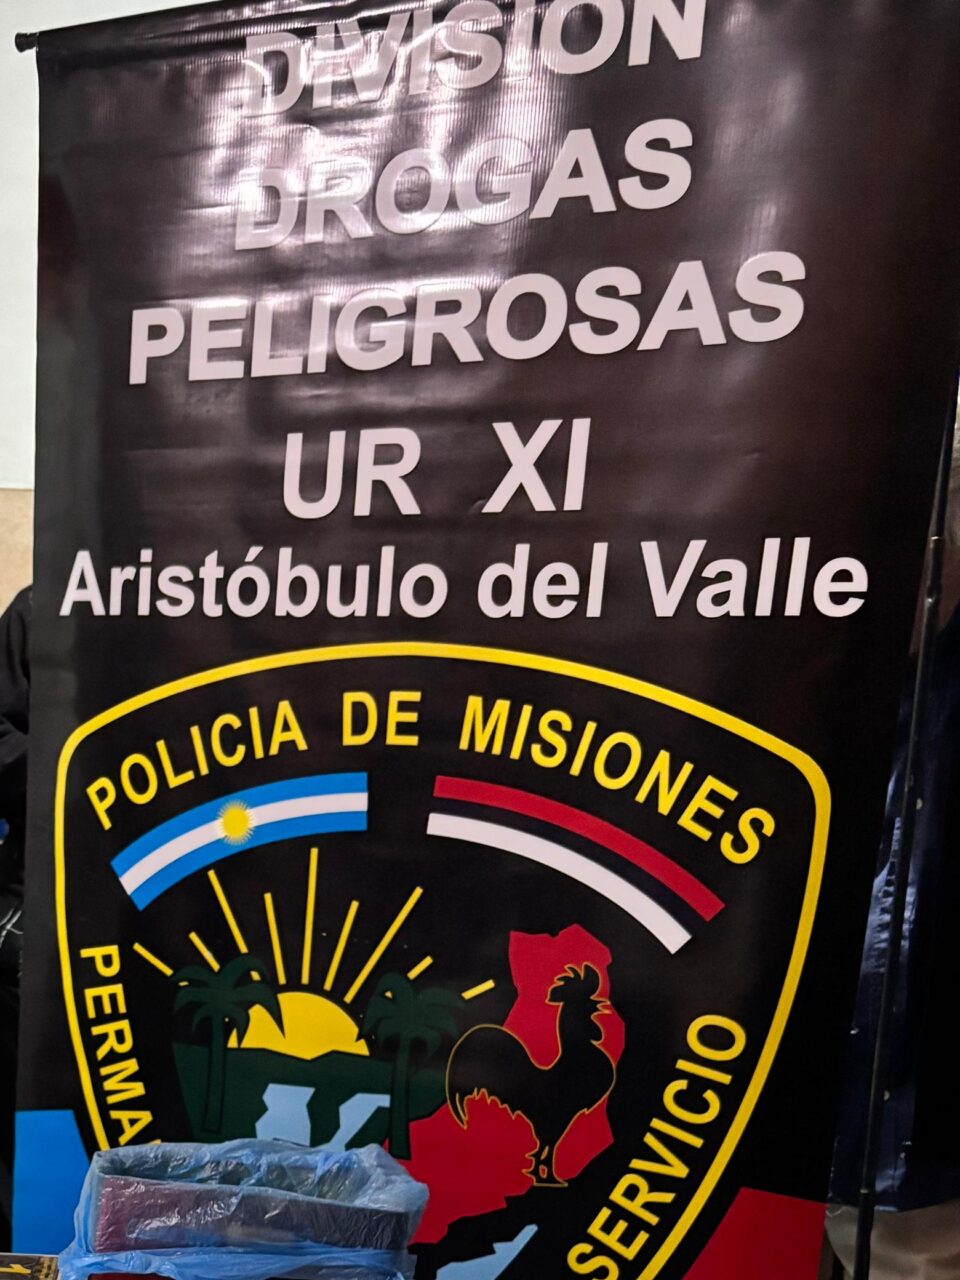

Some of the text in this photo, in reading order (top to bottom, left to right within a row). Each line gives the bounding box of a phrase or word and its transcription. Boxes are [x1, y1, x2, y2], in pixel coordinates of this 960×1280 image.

[233, 117, 695, 250] DROGAS
[128, 250, 807, 385] PELIGROSAS
[282, 417, 592, 519] UR XI
[59, 535, 869, 619] Aristóbulo del Valle
[85, 690, 777, 867] POLICIA DE MISIONES
[80, 944, 162, 1147] PERMA
